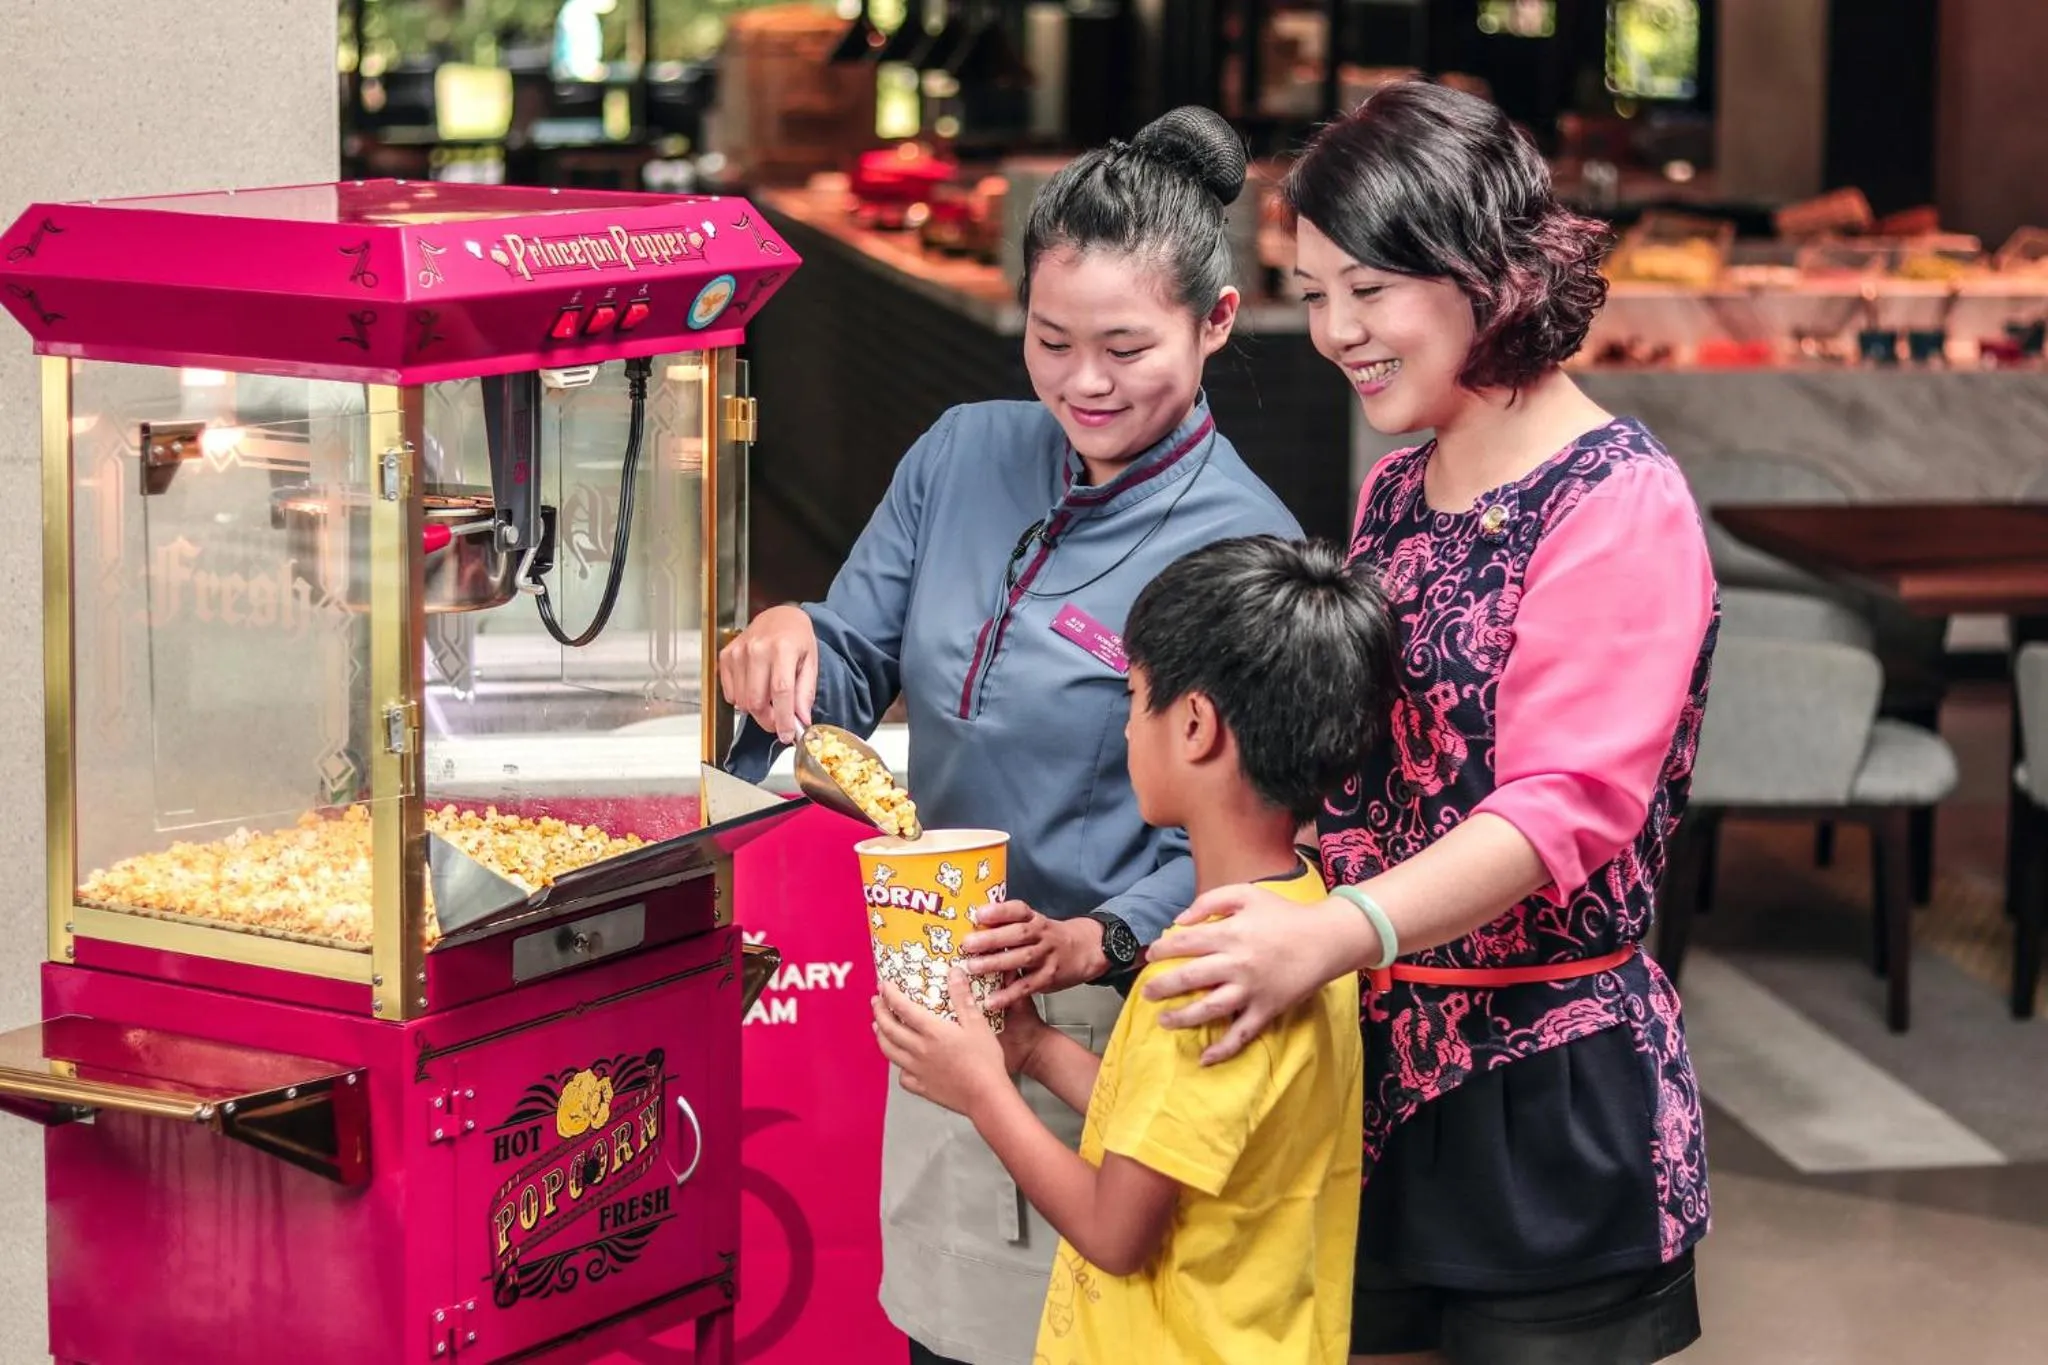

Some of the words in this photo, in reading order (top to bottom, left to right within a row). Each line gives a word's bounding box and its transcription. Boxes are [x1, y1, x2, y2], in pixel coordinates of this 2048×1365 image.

[504, 233, 619, 281] Princeton
[607, 225, 690, 271] Popper
[128, 534, 313, 640] Fresh
[494, 1125, 543, 1163] HOT
[494, 1096, 661, 1256] POPCORN
[600, 1186, 670, 1232] FRESH
